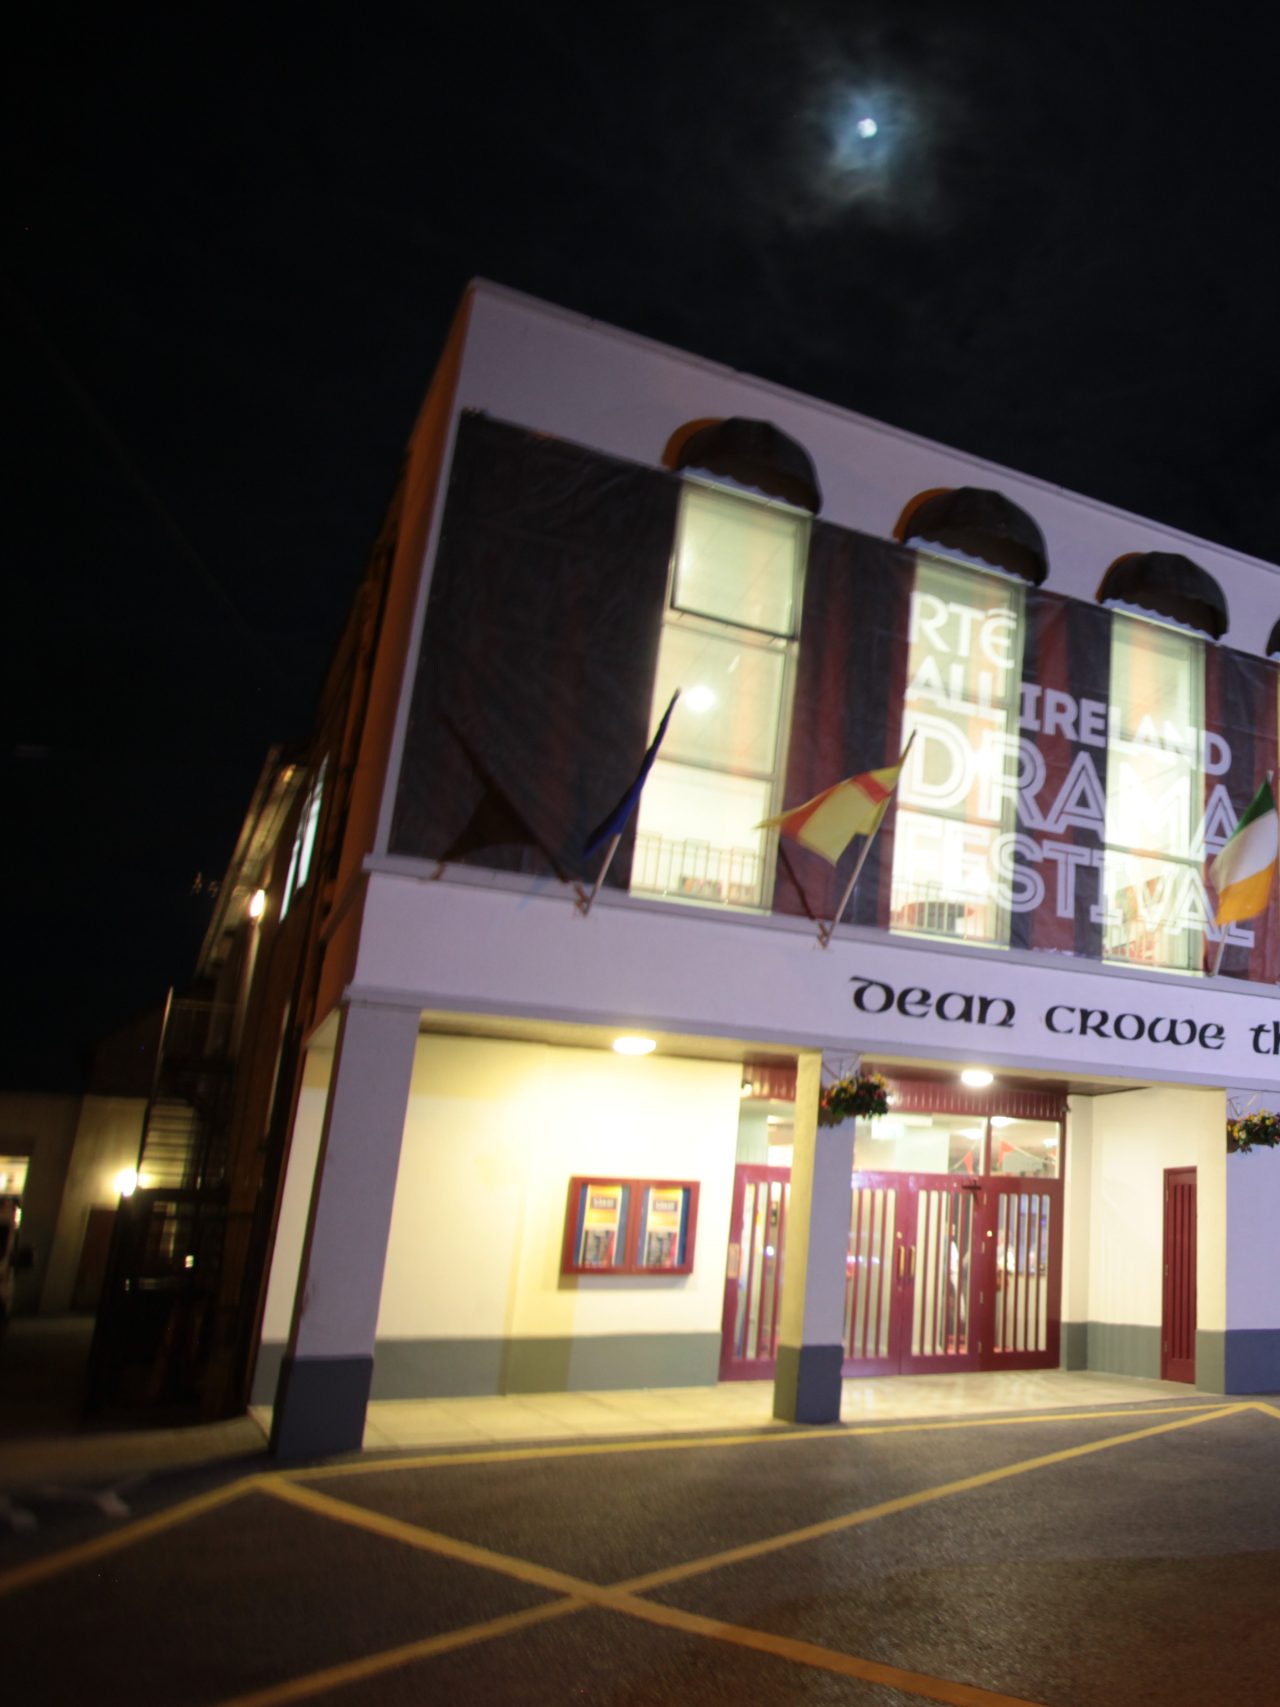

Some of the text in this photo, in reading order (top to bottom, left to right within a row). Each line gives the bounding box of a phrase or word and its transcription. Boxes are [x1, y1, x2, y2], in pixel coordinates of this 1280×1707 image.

[904, 655, 1232, 776] ALL IRELAND
[897, 710, 1242, 861] DRAMA
